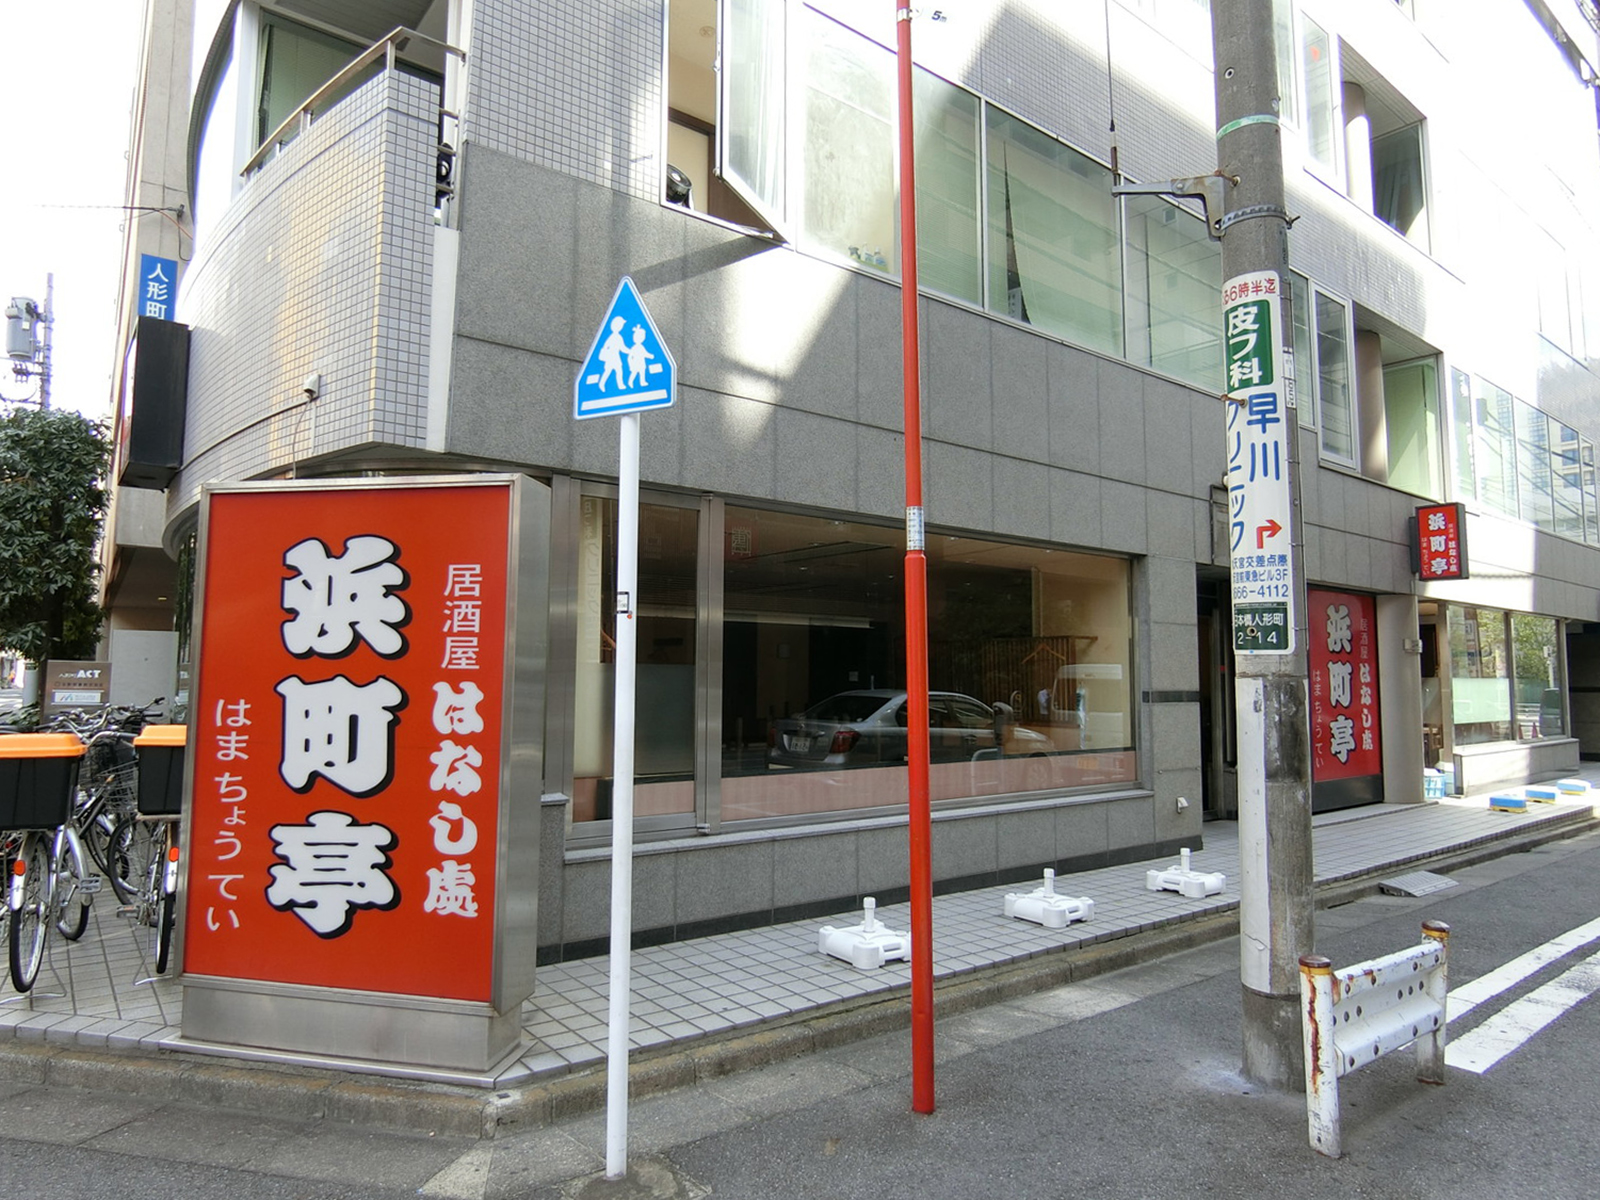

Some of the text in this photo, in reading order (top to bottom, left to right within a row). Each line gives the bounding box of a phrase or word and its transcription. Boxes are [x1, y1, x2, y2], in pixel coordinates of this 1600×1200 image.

[147, 263, 169, 320] 人形町
[1228, 305, 1262, 388] 皮フ科
[1247, 392, 1281, 482] 早川
[1428, 512, 1448, 575] 浜町亭
[1326, 604, 1355, 765] 浜町亭
[266, 535, 408, 938] 浜町亭
[207, 698, 252, 932] はまちょうてい
